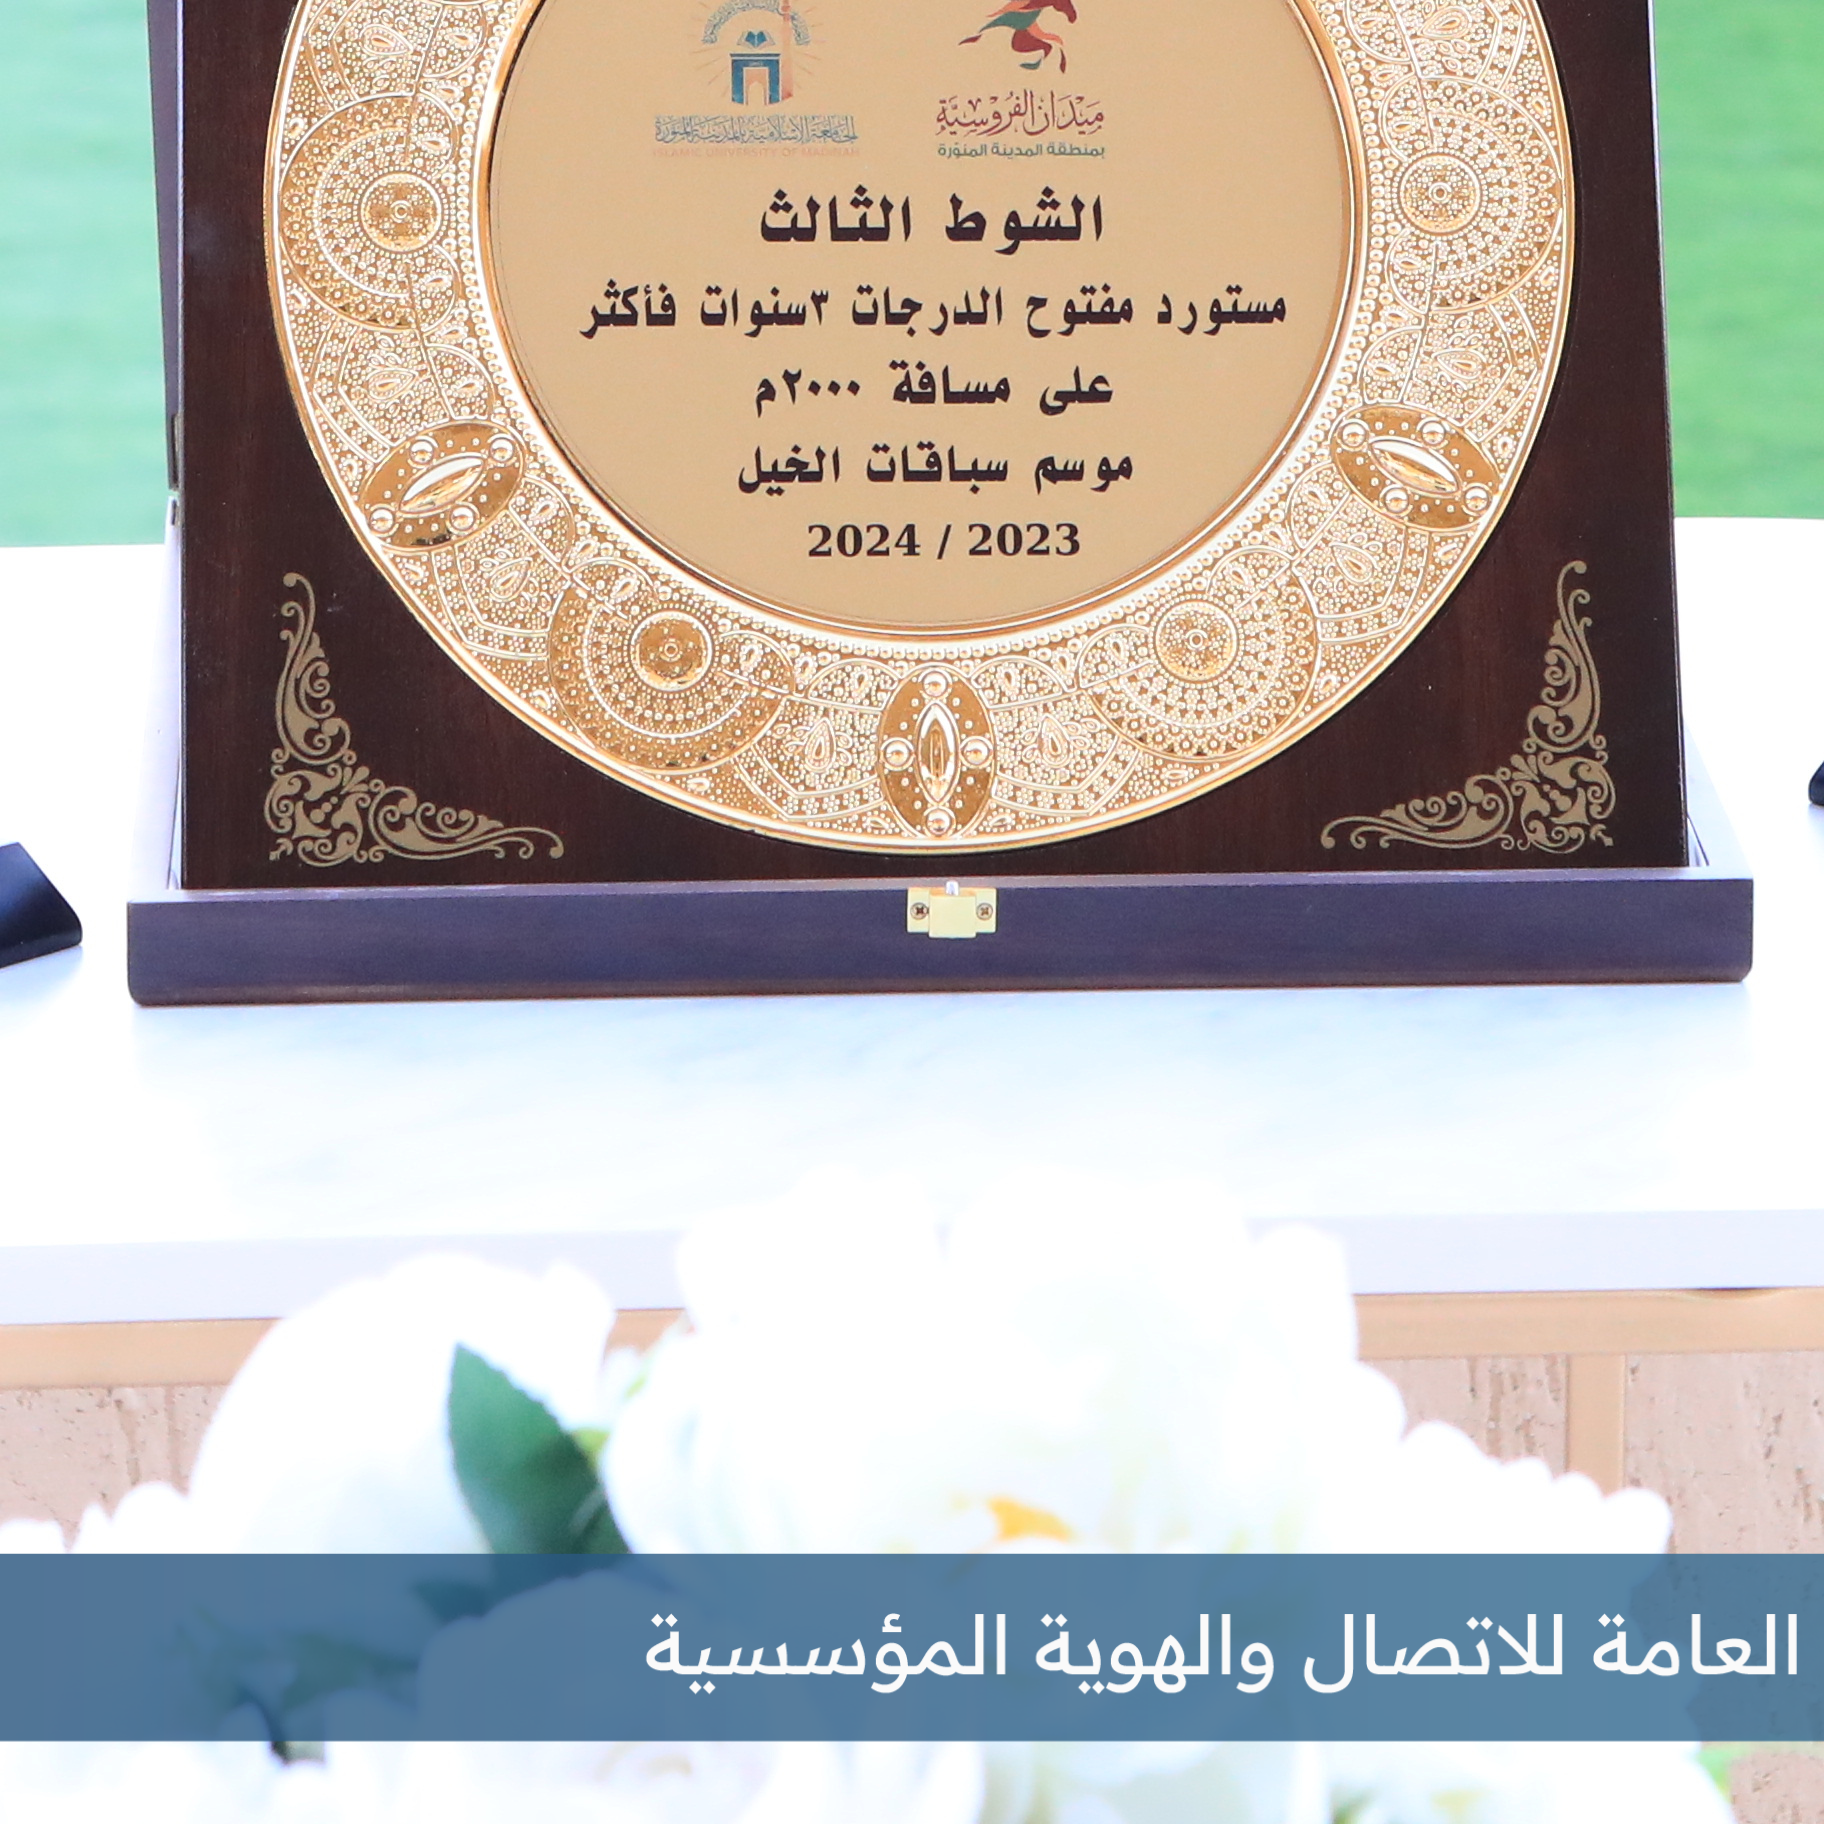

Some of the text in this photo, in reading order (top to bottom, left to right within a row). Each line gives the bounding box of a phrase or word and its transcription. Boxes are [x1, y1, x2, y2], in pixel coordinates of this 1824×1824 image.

[991, 142, 1043, 159] المدينة
[1047, 142, 1105, 159] بمنطقة
[760, 184, 1103, 256] الشوط الثالث
[579, 278, 677, 339] فأكثر
[851, 284, 1003, 338] الدرجات
[1026, 282, 1134, 339] مفتوح
[1157, 285, 1287, 338] مستورد
[888, 359, 1011, 406] مسافة
[1039, 365, 1113, 417] على
[738, 440, 1133, 497] موسم سباقات الخيل
[808, 523, 921, 558] 2024
[968, 522, 1080, 558] 2023
